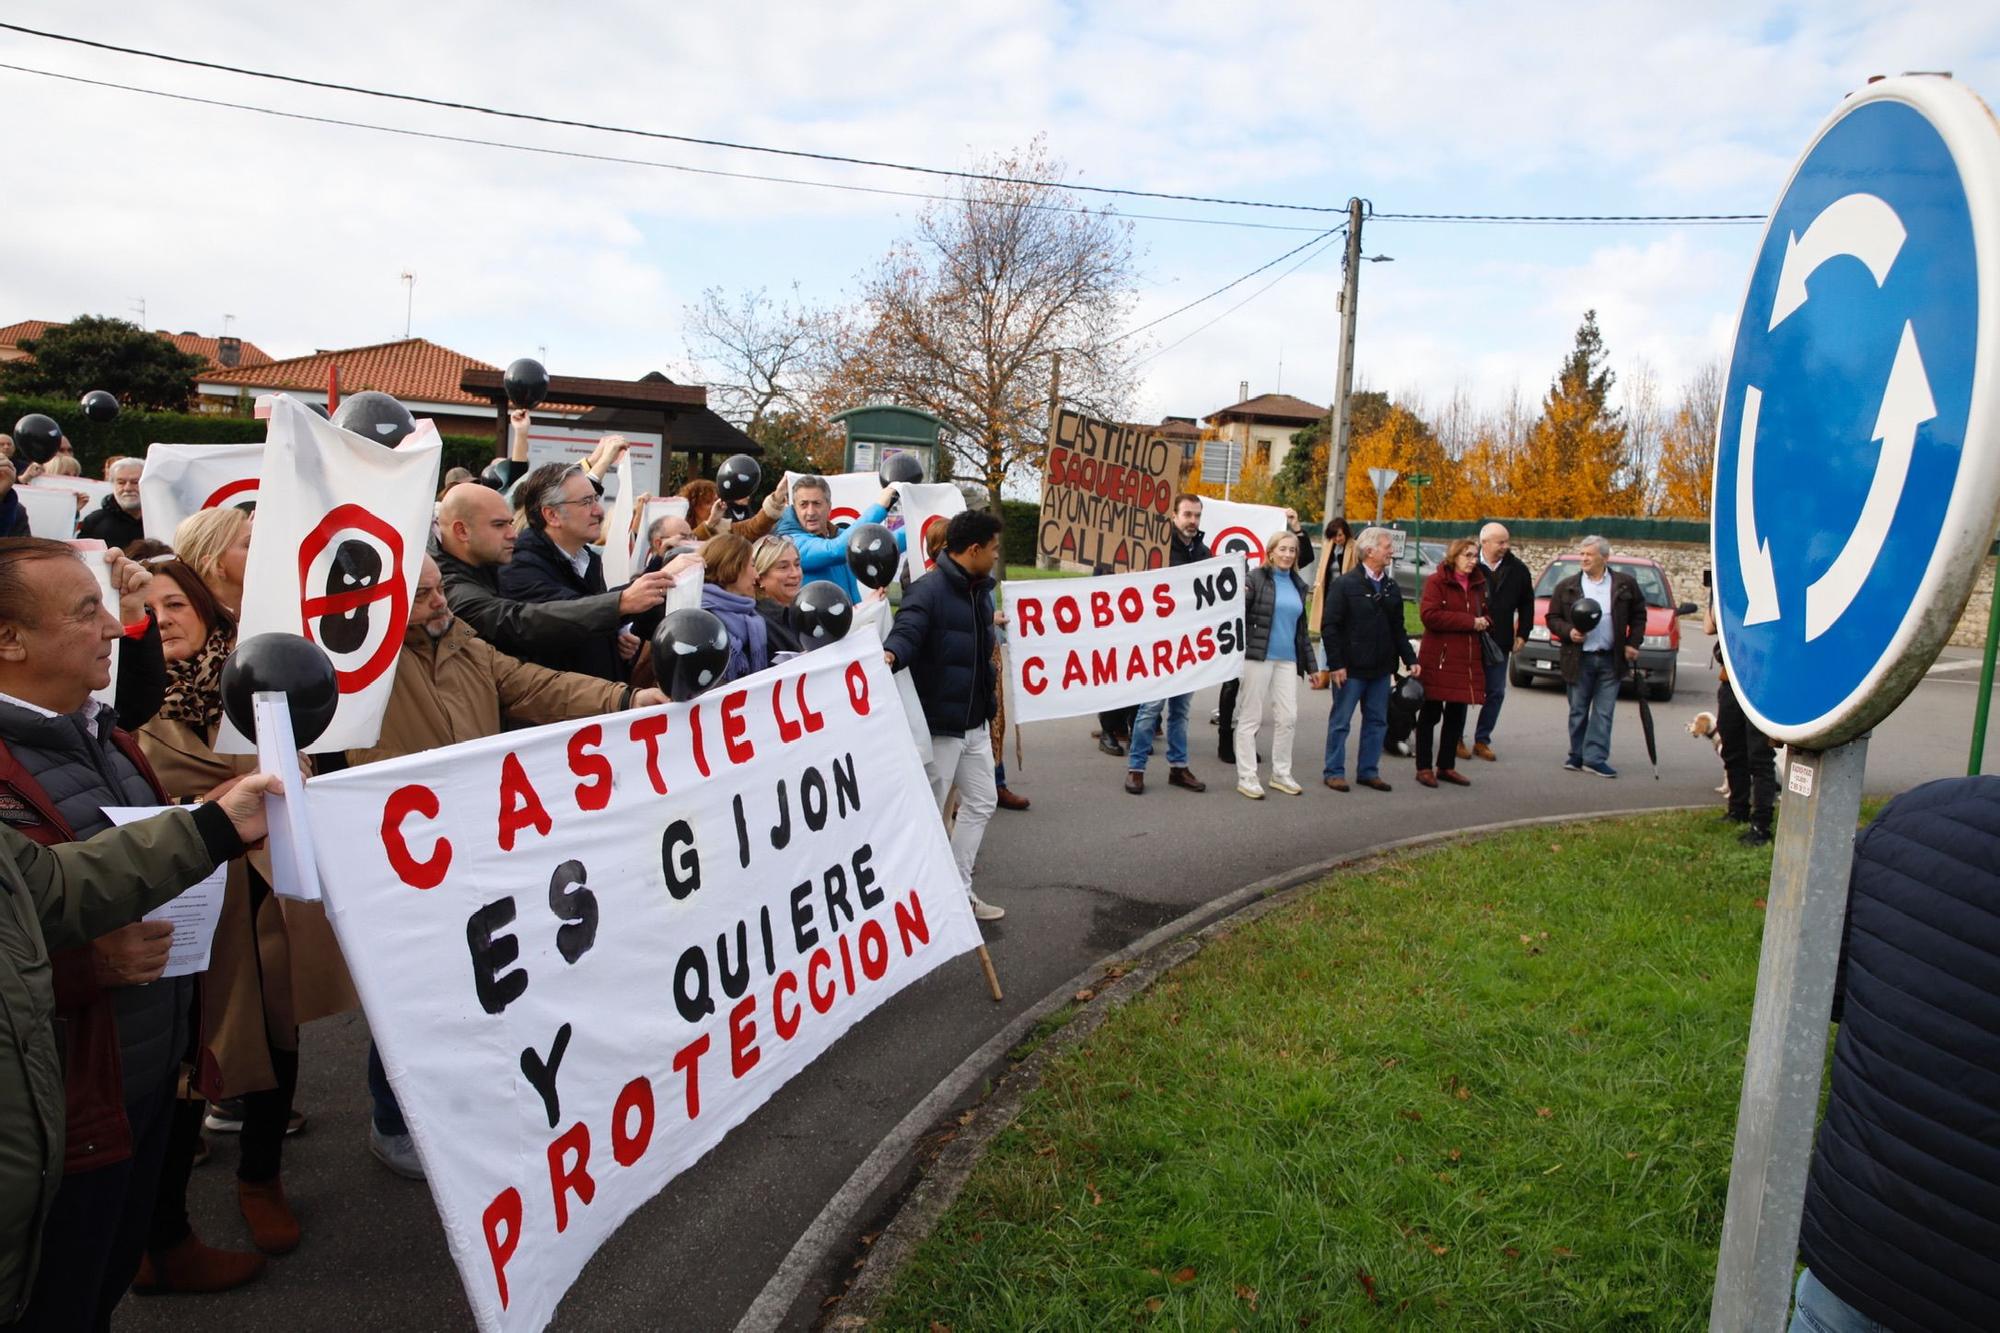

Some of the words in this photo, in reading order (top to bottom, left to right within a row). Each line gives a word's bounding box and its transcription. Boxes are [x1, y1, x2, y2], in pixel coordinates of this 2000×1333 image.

[1056, 409, 1168, 476] CASTIELLO
[1043, 486, 1172, 545] AYUNTAMIENTO
[1048, 447, 1171, 514] SAQUEADO
[1040, 520, 1164, 573] CALLADO
[1017, 584, 1176, 637] ROBOS
[1193, 566, 1238, 610] NO
[1022, 627, 1216, 695] CAMARAS
[1216, 618, 1244, 655] SI
[381, 661, 870, 890] CASTIELLO
[466, 859, 599, 1015] ES
[661, 752, 861, 900] GIJON
[520, 1023, 572, 1129] Y
[672, 843, 885, 1023] QUIERE
[482, 890, 930, 1312] PROTECCION
